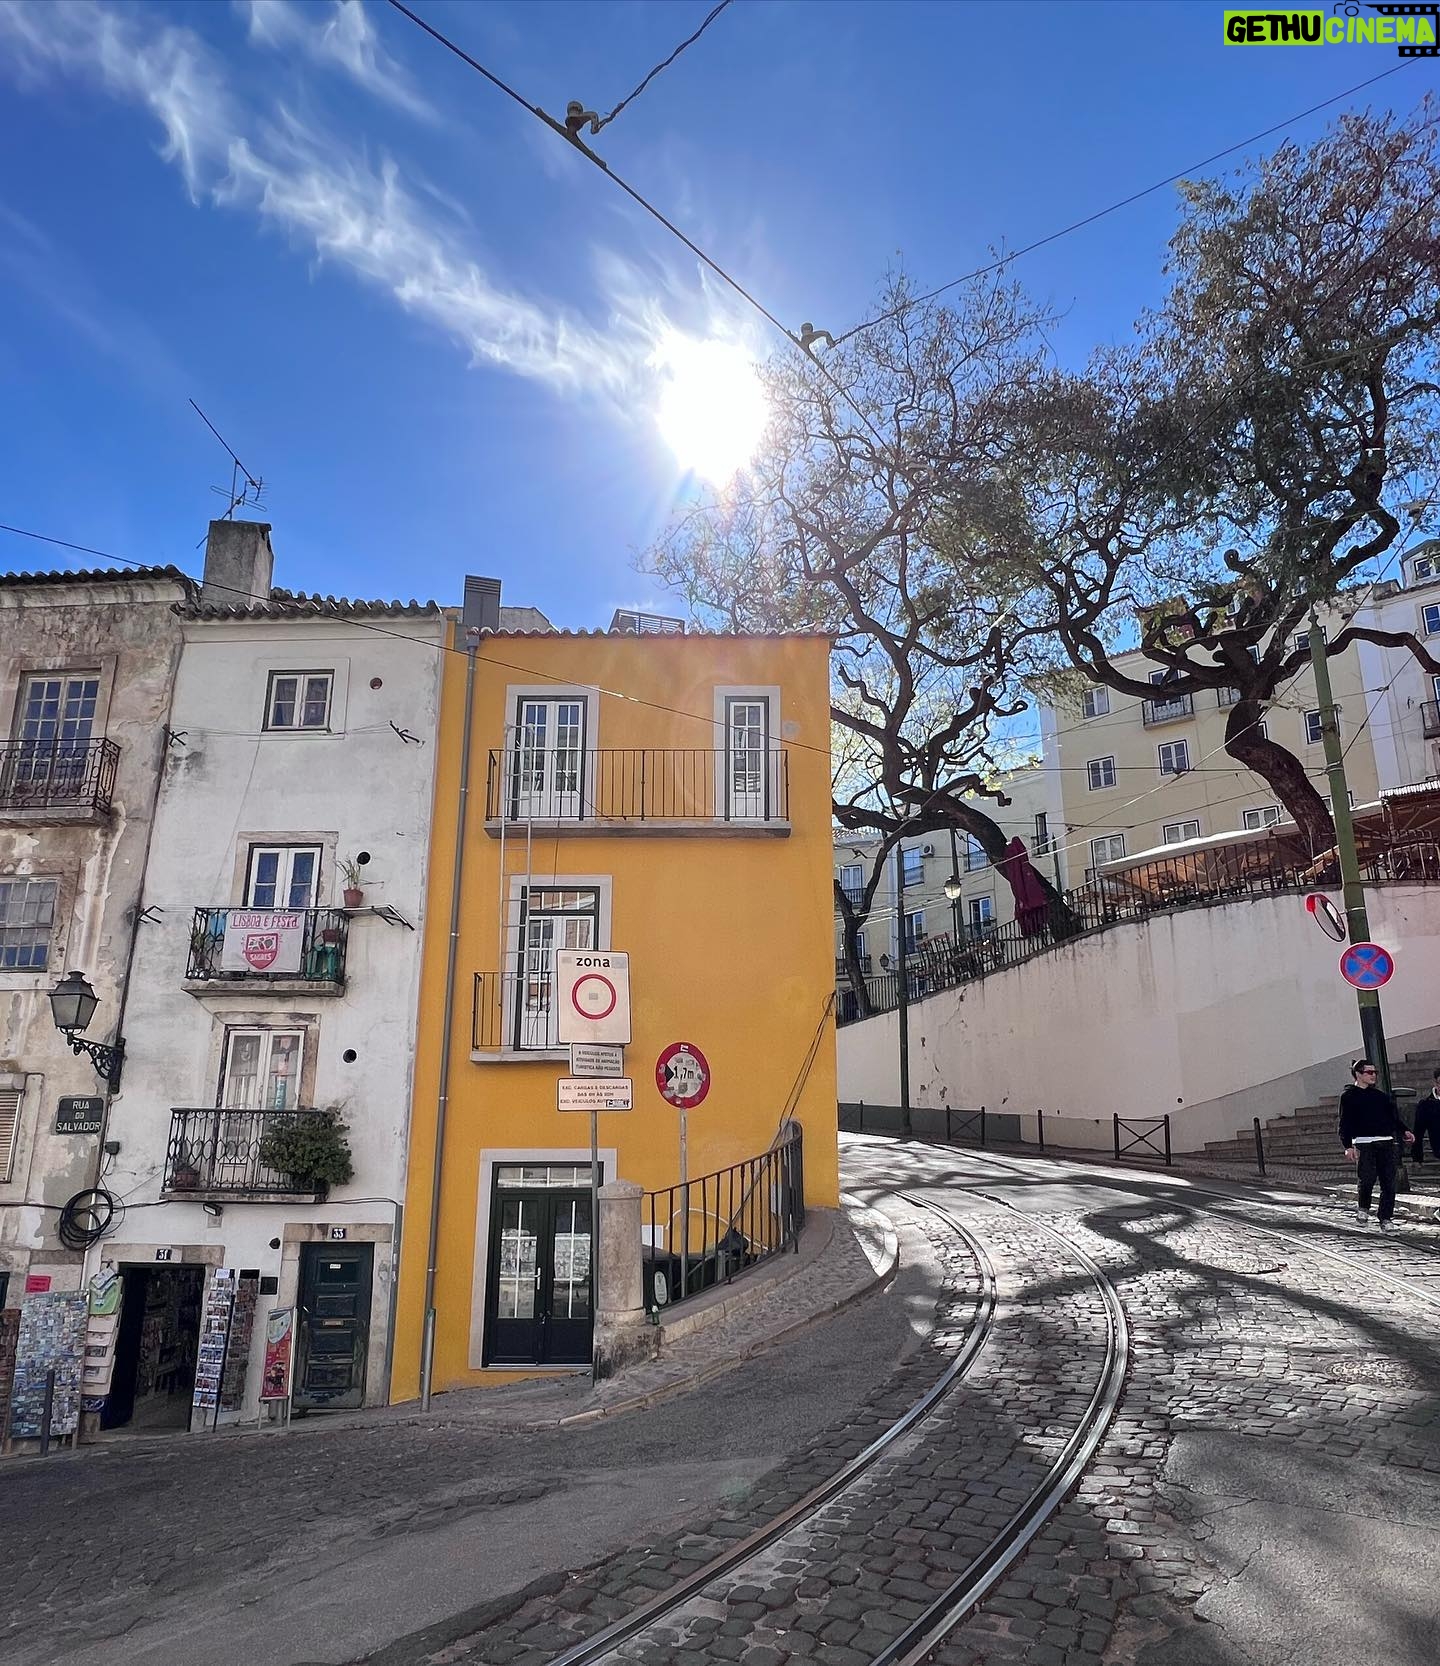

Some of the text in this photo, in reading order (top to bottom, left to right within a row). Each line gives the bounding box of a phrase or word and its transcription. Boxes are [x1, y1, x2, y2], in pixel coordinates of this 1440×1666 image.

[576, 956, 611, 968] zona
[673, 1065, 694, 1080] 1,7m
[72, 1100, 90, 1110] RUA
[74, 1111, 85, 1120] DO
[56, 1121, 101, 1131] SALVADOR
[333, 1228, 344, 1239] 33
[158, 1249, 169, 1260] 31
